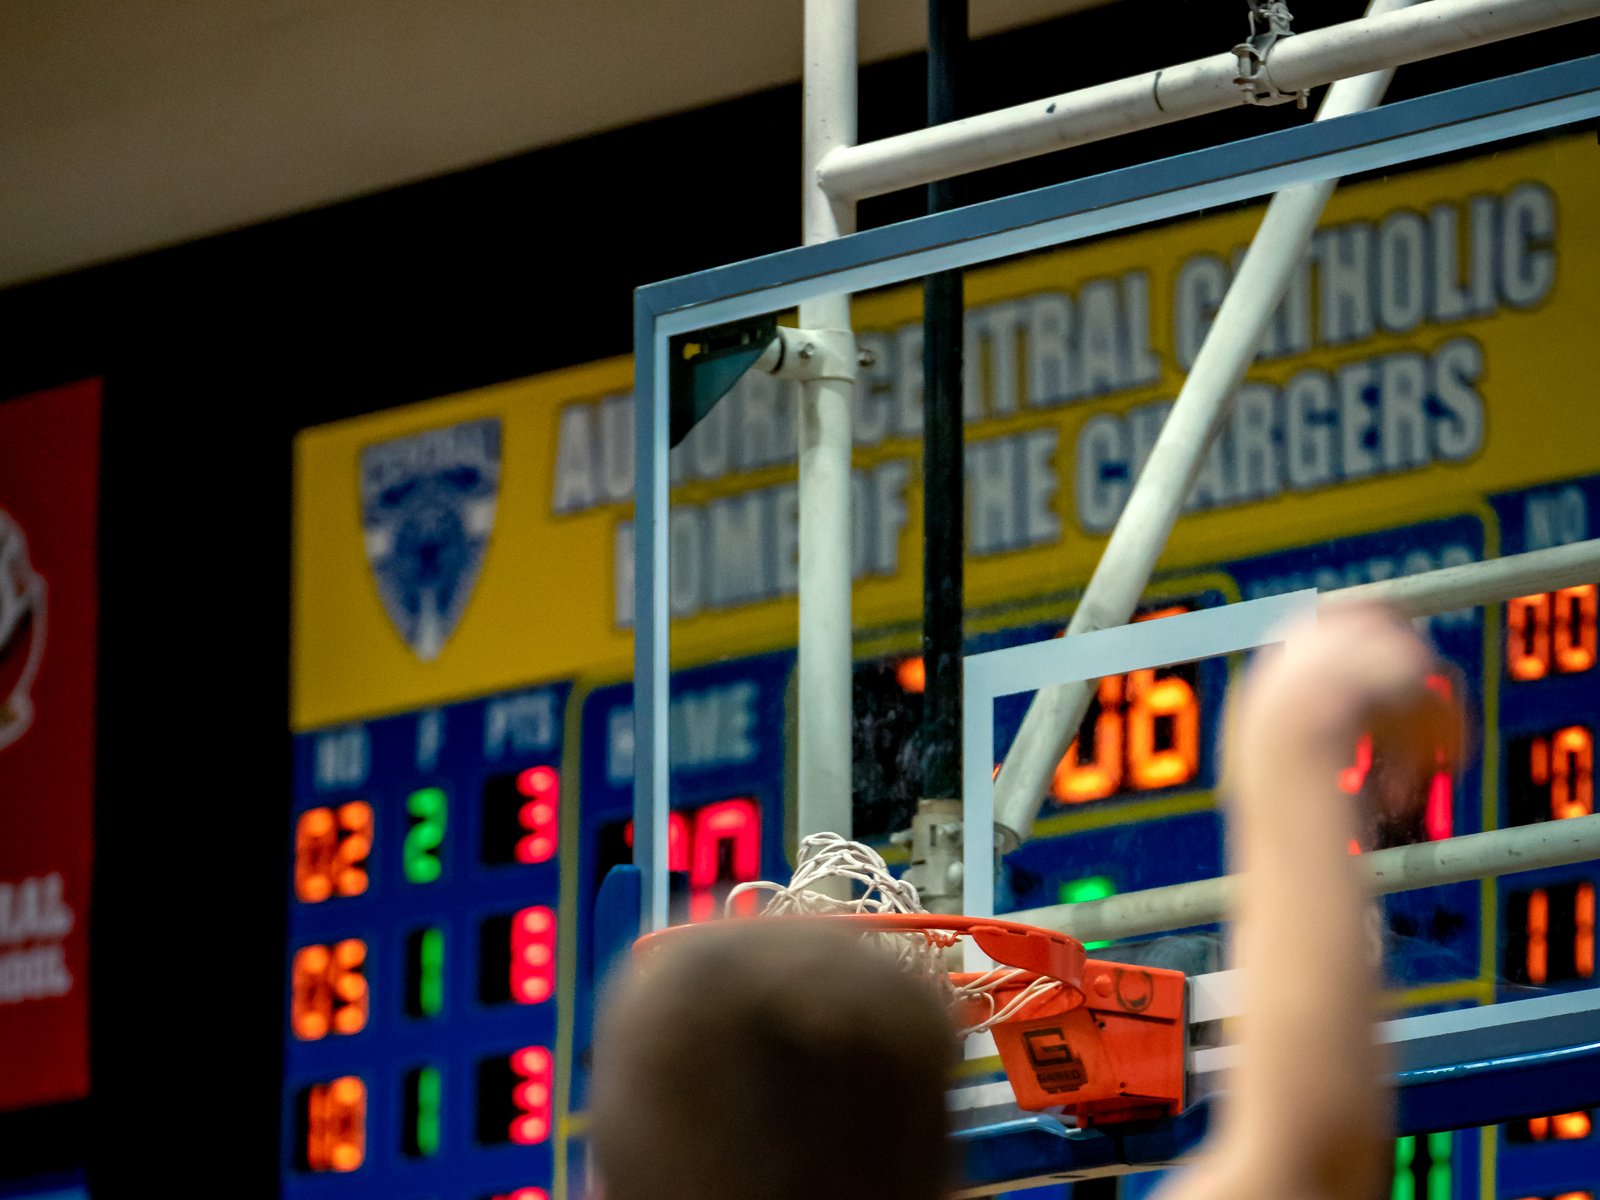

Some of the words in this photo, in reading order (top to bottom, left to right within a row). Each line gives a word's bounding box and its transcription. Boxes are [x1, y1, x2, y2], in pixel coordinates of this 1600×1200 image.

[1175, 182, 1556, 374] CTHOLIC
[1506, 583, 1598, 681] 00
[403, 787, 448, 884] 2
[1526, 882, 1596, 985] 11
